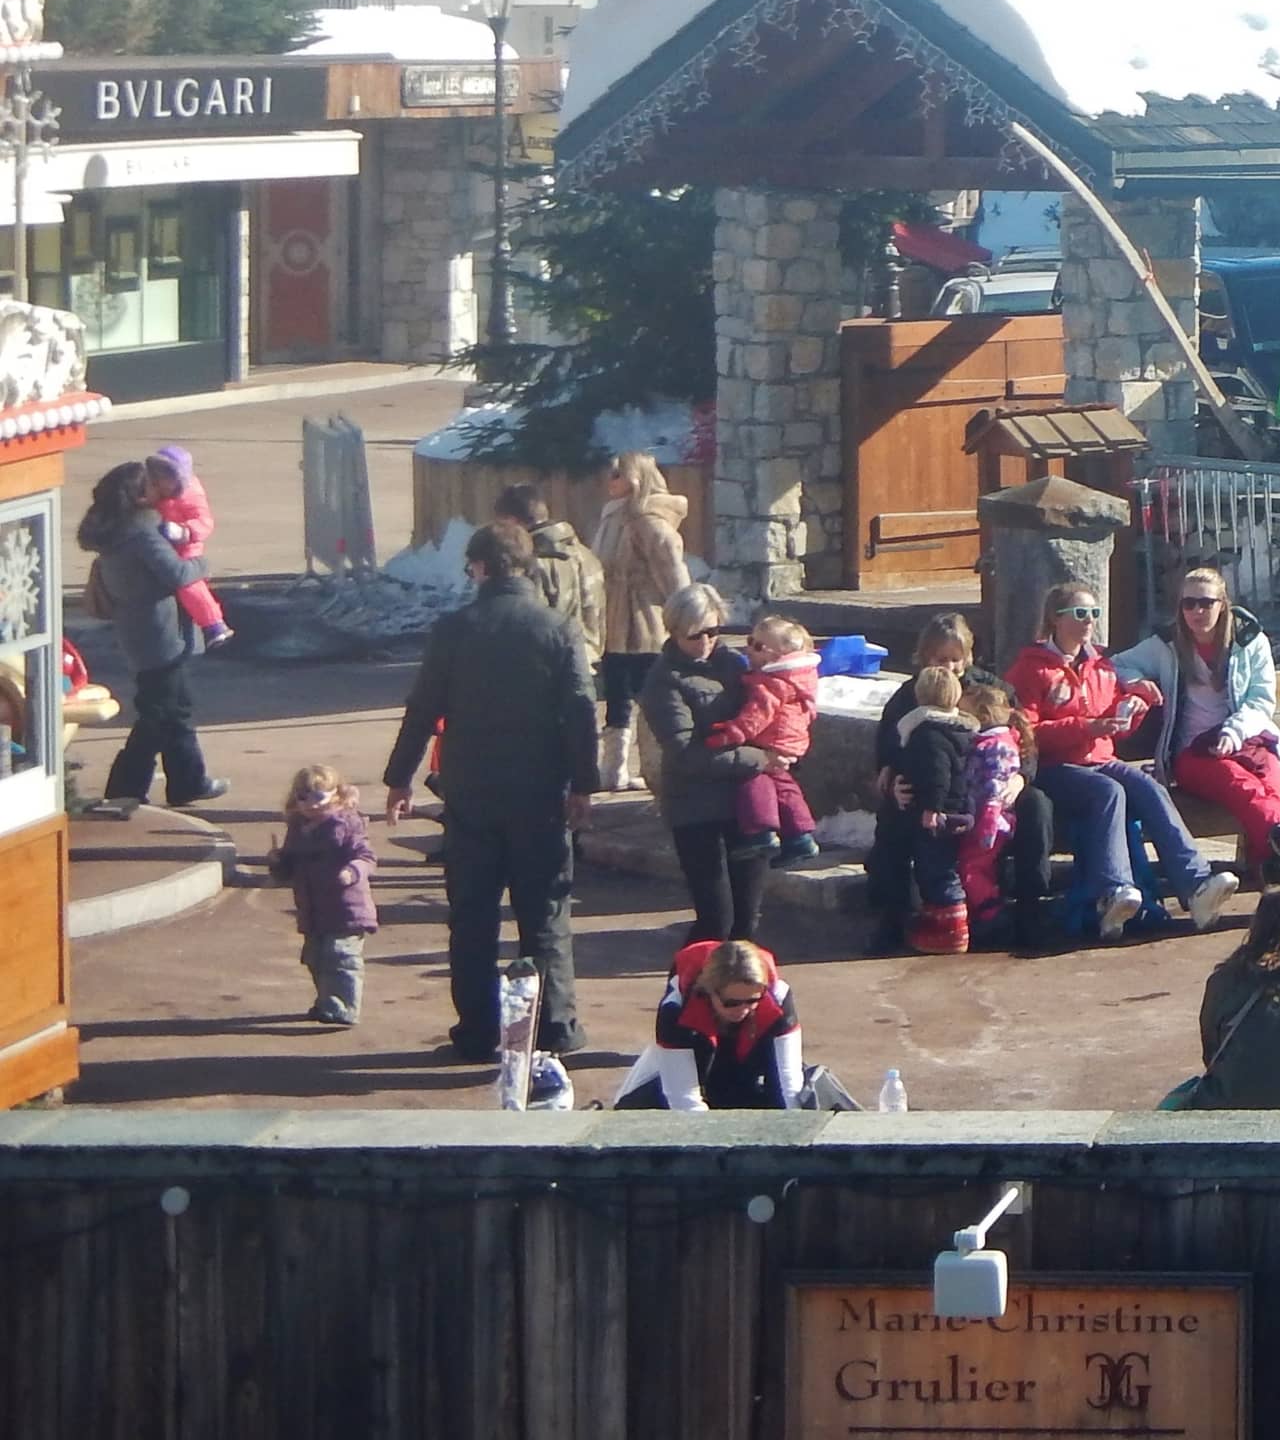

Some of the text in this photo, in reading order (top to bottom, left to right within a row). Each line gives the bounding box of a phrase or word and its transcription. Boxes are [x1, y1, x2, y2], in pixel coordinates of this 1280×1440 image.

[96, 77, 272, 119] BVLGARI
[838, 1294, 1200, 1334] Marie-Christine
[835, 1354, 1037, 1404] Grulier
